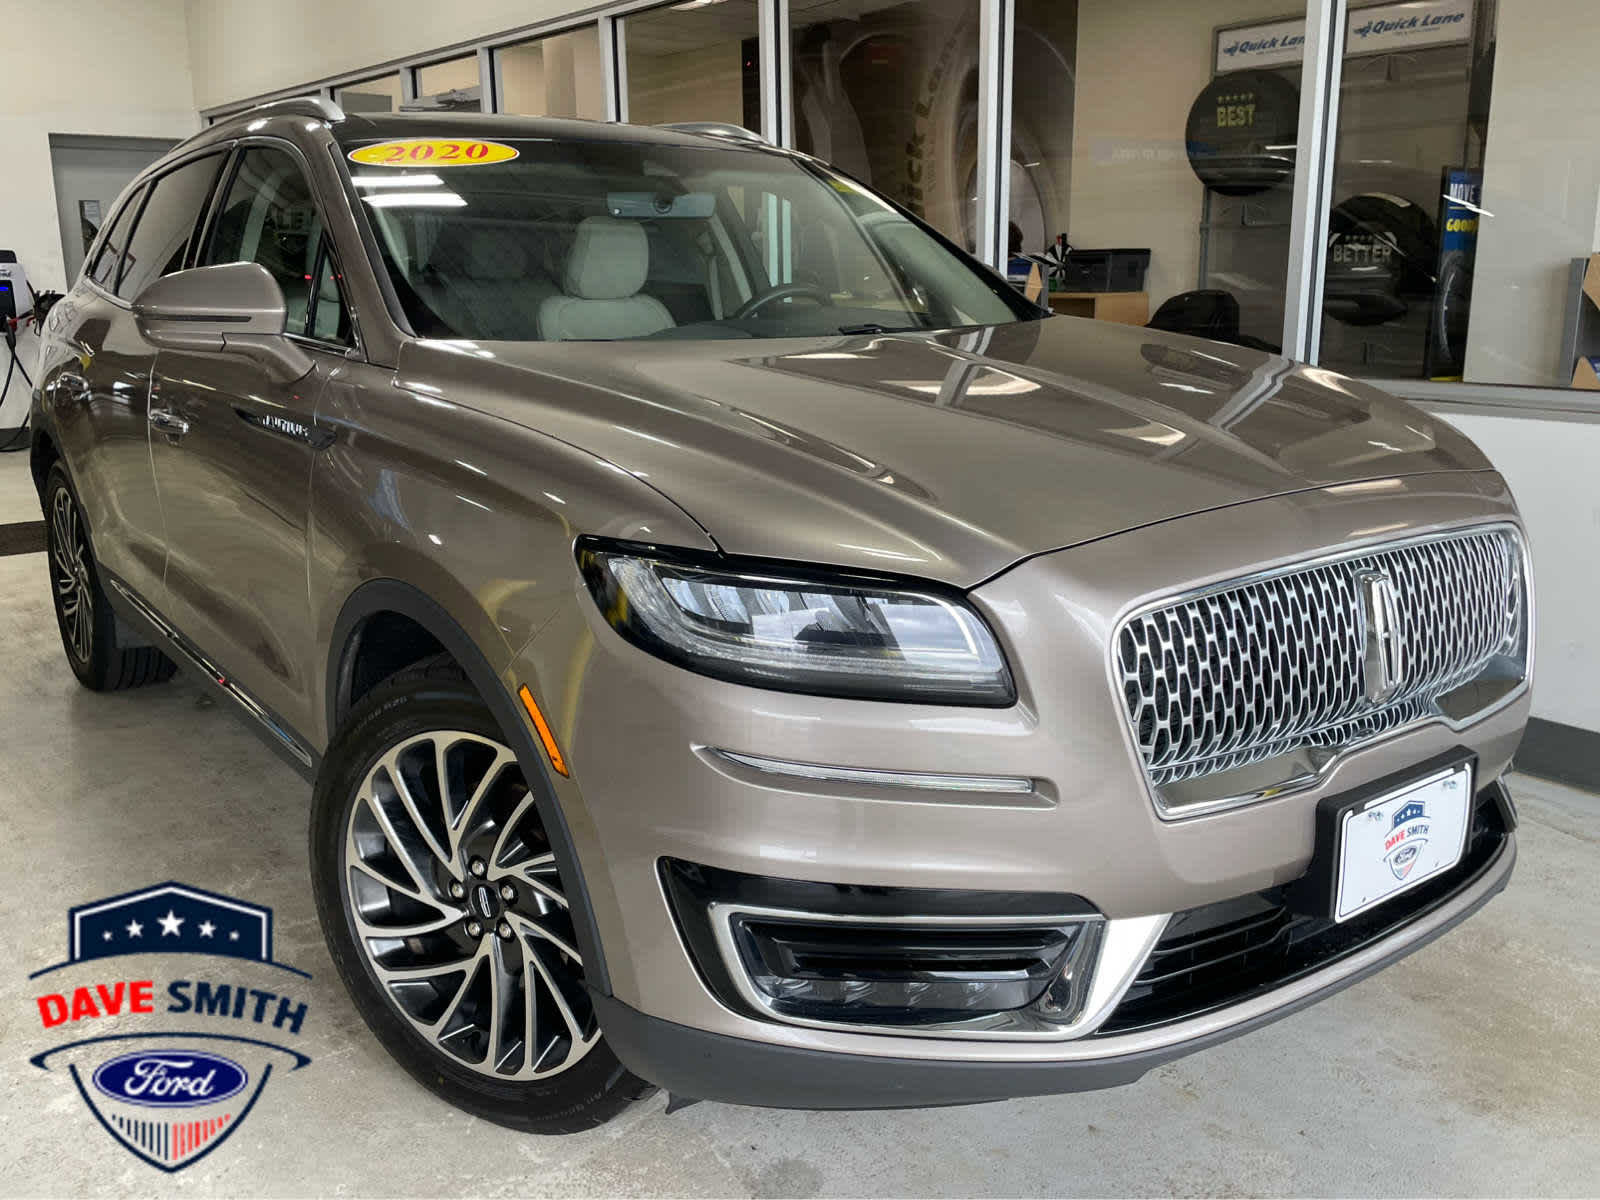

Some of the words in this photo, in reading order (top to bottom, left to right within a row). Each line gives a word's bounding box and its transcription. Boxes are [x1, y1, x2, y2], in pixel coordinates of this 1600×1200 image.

[1372, 15, 1418, 33] Quick
[1421, 13, 1464, 26] Lane
[1239, 37, 1278, 54] Quick
[1280, 36, 1305, 47] Lan
[1217, 104, 1256, 127] BEST
[384, 143, 489, 163] 2020
[1333, 243, 1393, 264] BETTER
[1385, 830, 1405, 850] DAVE
[1407, 825, 1429, 837] SMITH
